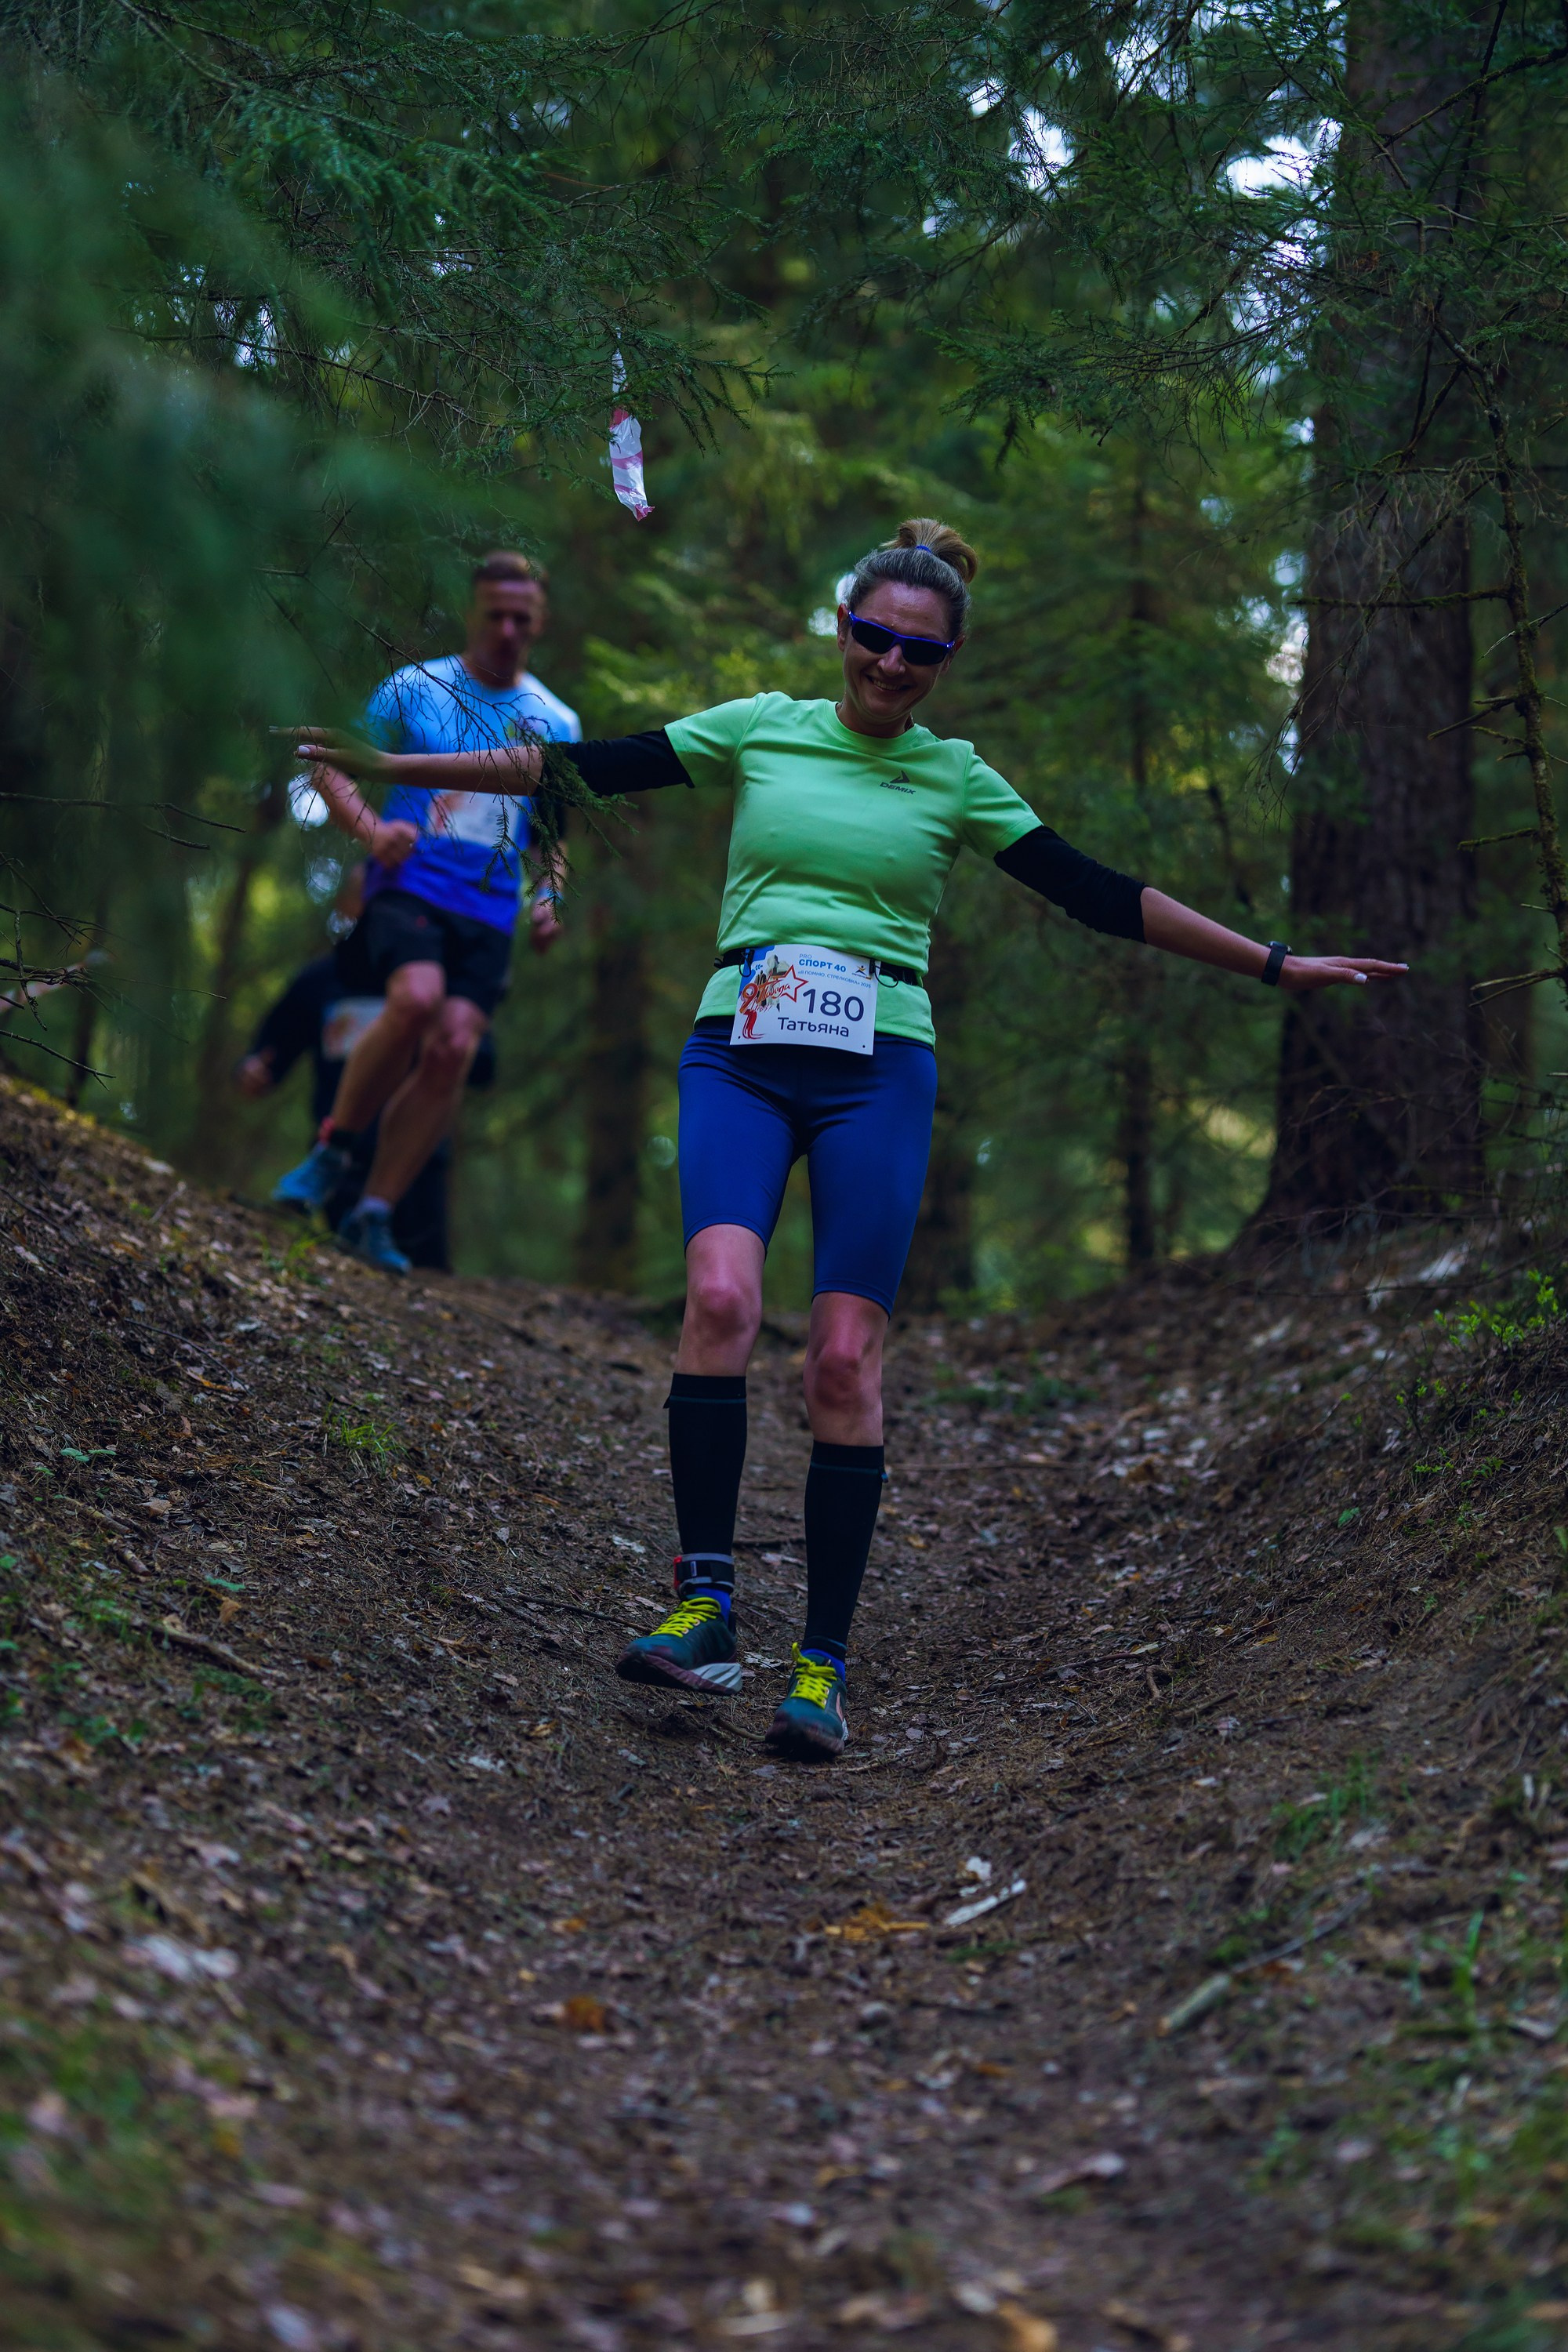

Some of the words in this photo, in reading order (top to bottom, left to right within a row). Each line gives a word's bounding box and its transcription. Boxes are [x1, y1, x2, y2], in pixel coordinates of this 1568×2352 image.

[880, 782, 916, 794] DEMIX
[799, 959, 833, 969] СПОРТ
[803, 989, 864, 1022] 180
[777, 1017, 849, 1037] Татьяна
